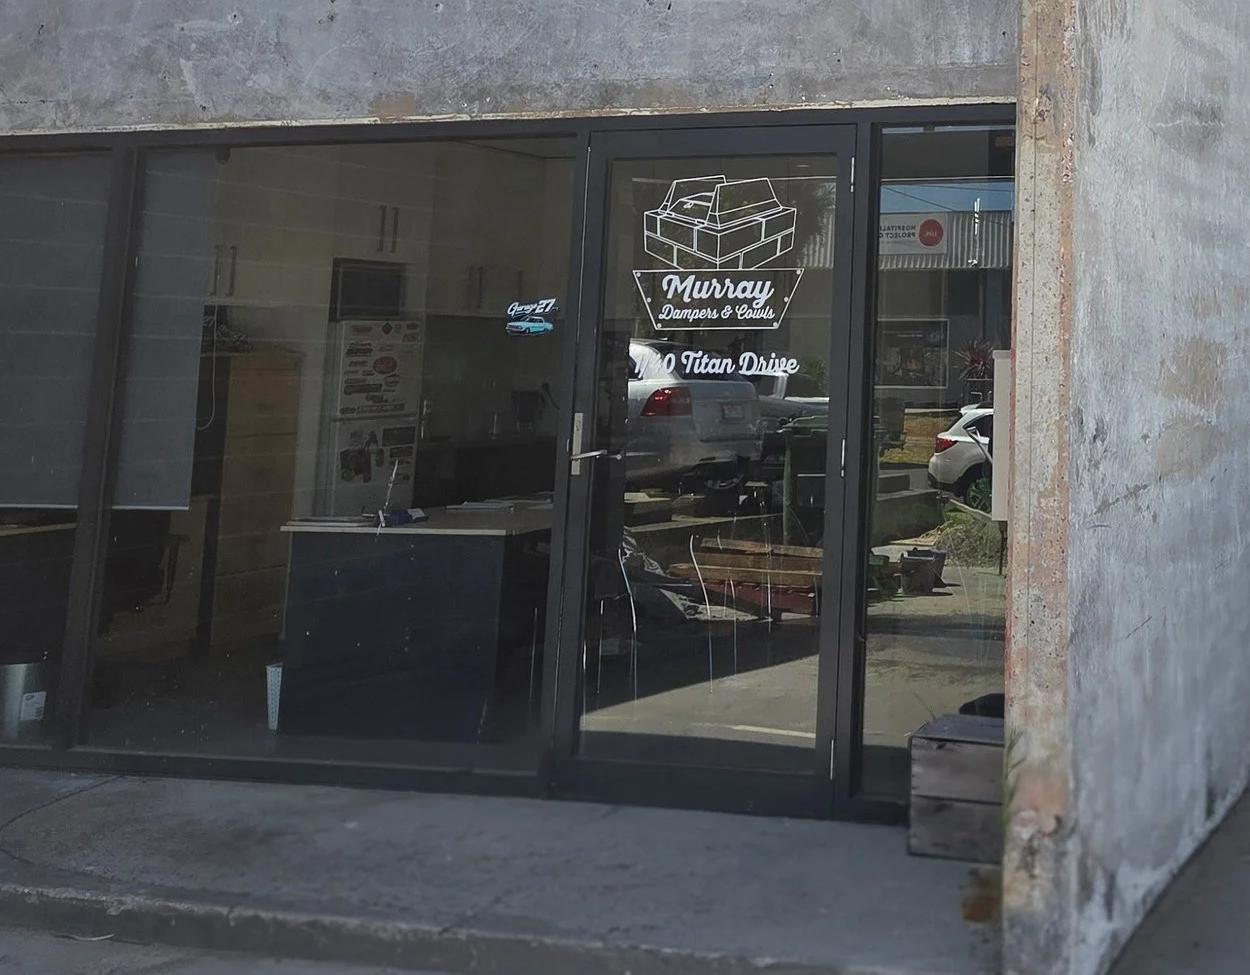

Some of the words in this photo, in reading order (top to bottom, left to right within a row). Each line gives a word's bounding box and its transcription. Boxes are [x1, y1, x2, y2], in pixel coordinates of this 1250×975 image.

[662, 274, 775, 309] Murray
[534, 298, 556, 314] 27
[658, 304, 719, 322] Dampers
[721, 304, 732, 319] &
[735, 304, 775, 320] Cowls
[680, 350, 735, 374] Titan
[738, 352, 800, 375] Drive
